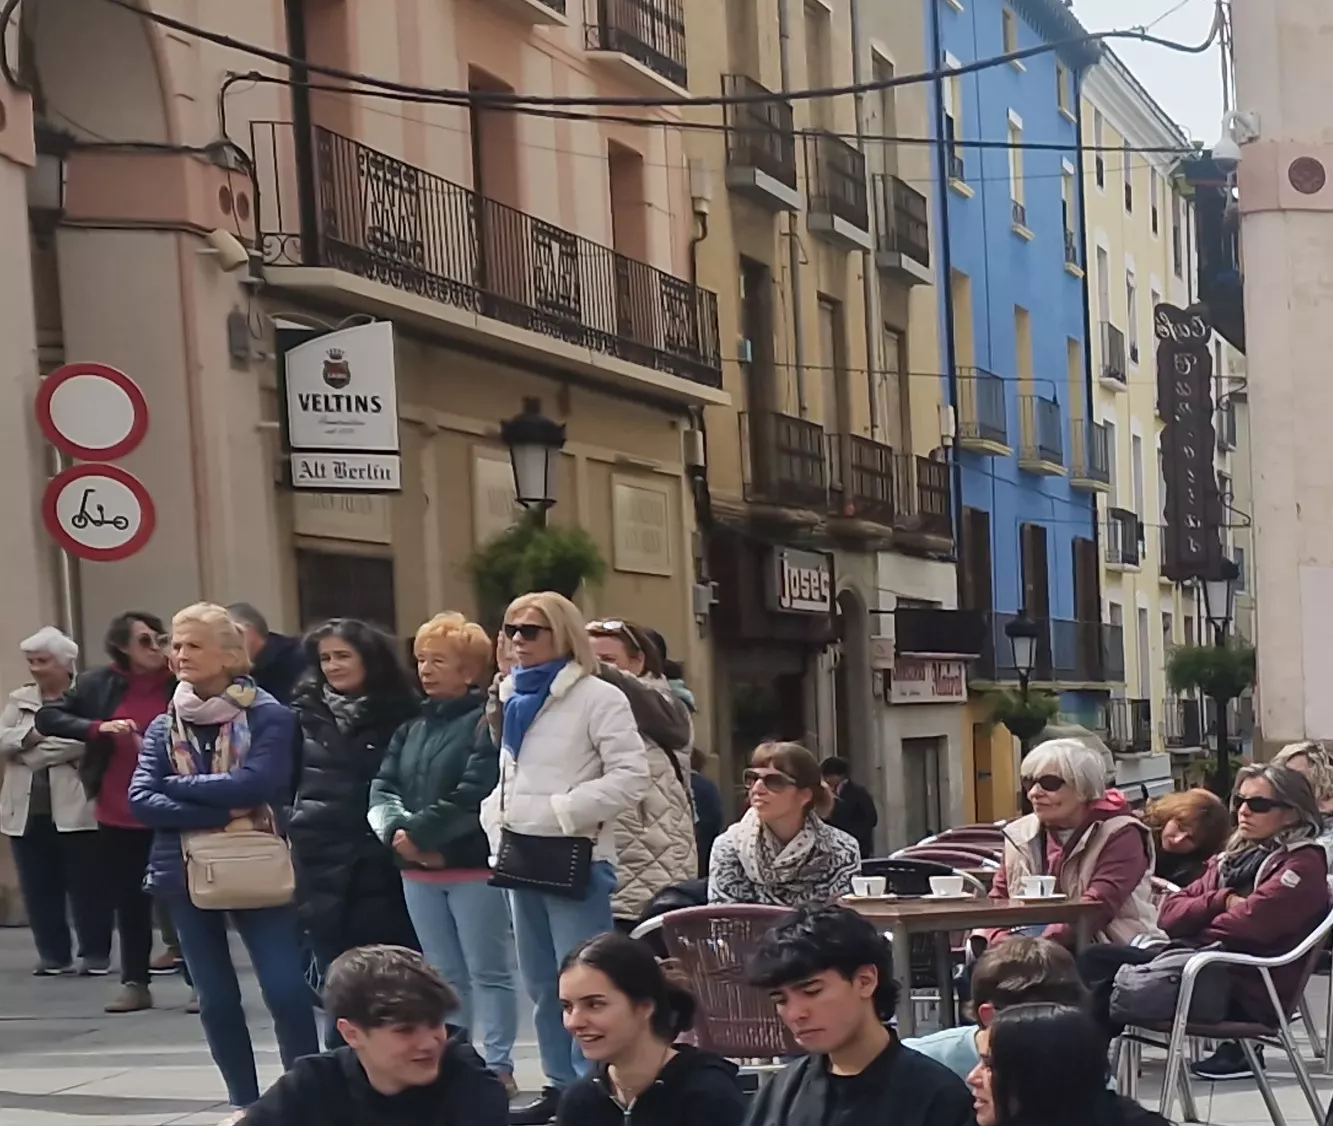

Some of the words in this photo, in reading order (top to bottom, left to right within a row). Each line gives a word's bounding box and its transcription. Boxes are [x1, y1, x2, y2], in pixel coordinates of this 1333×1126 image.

[297, 393, 382, 414] VELTINS
[299, 460, 326, 480] Alt
[332, 461, 391, 481] Berlin
